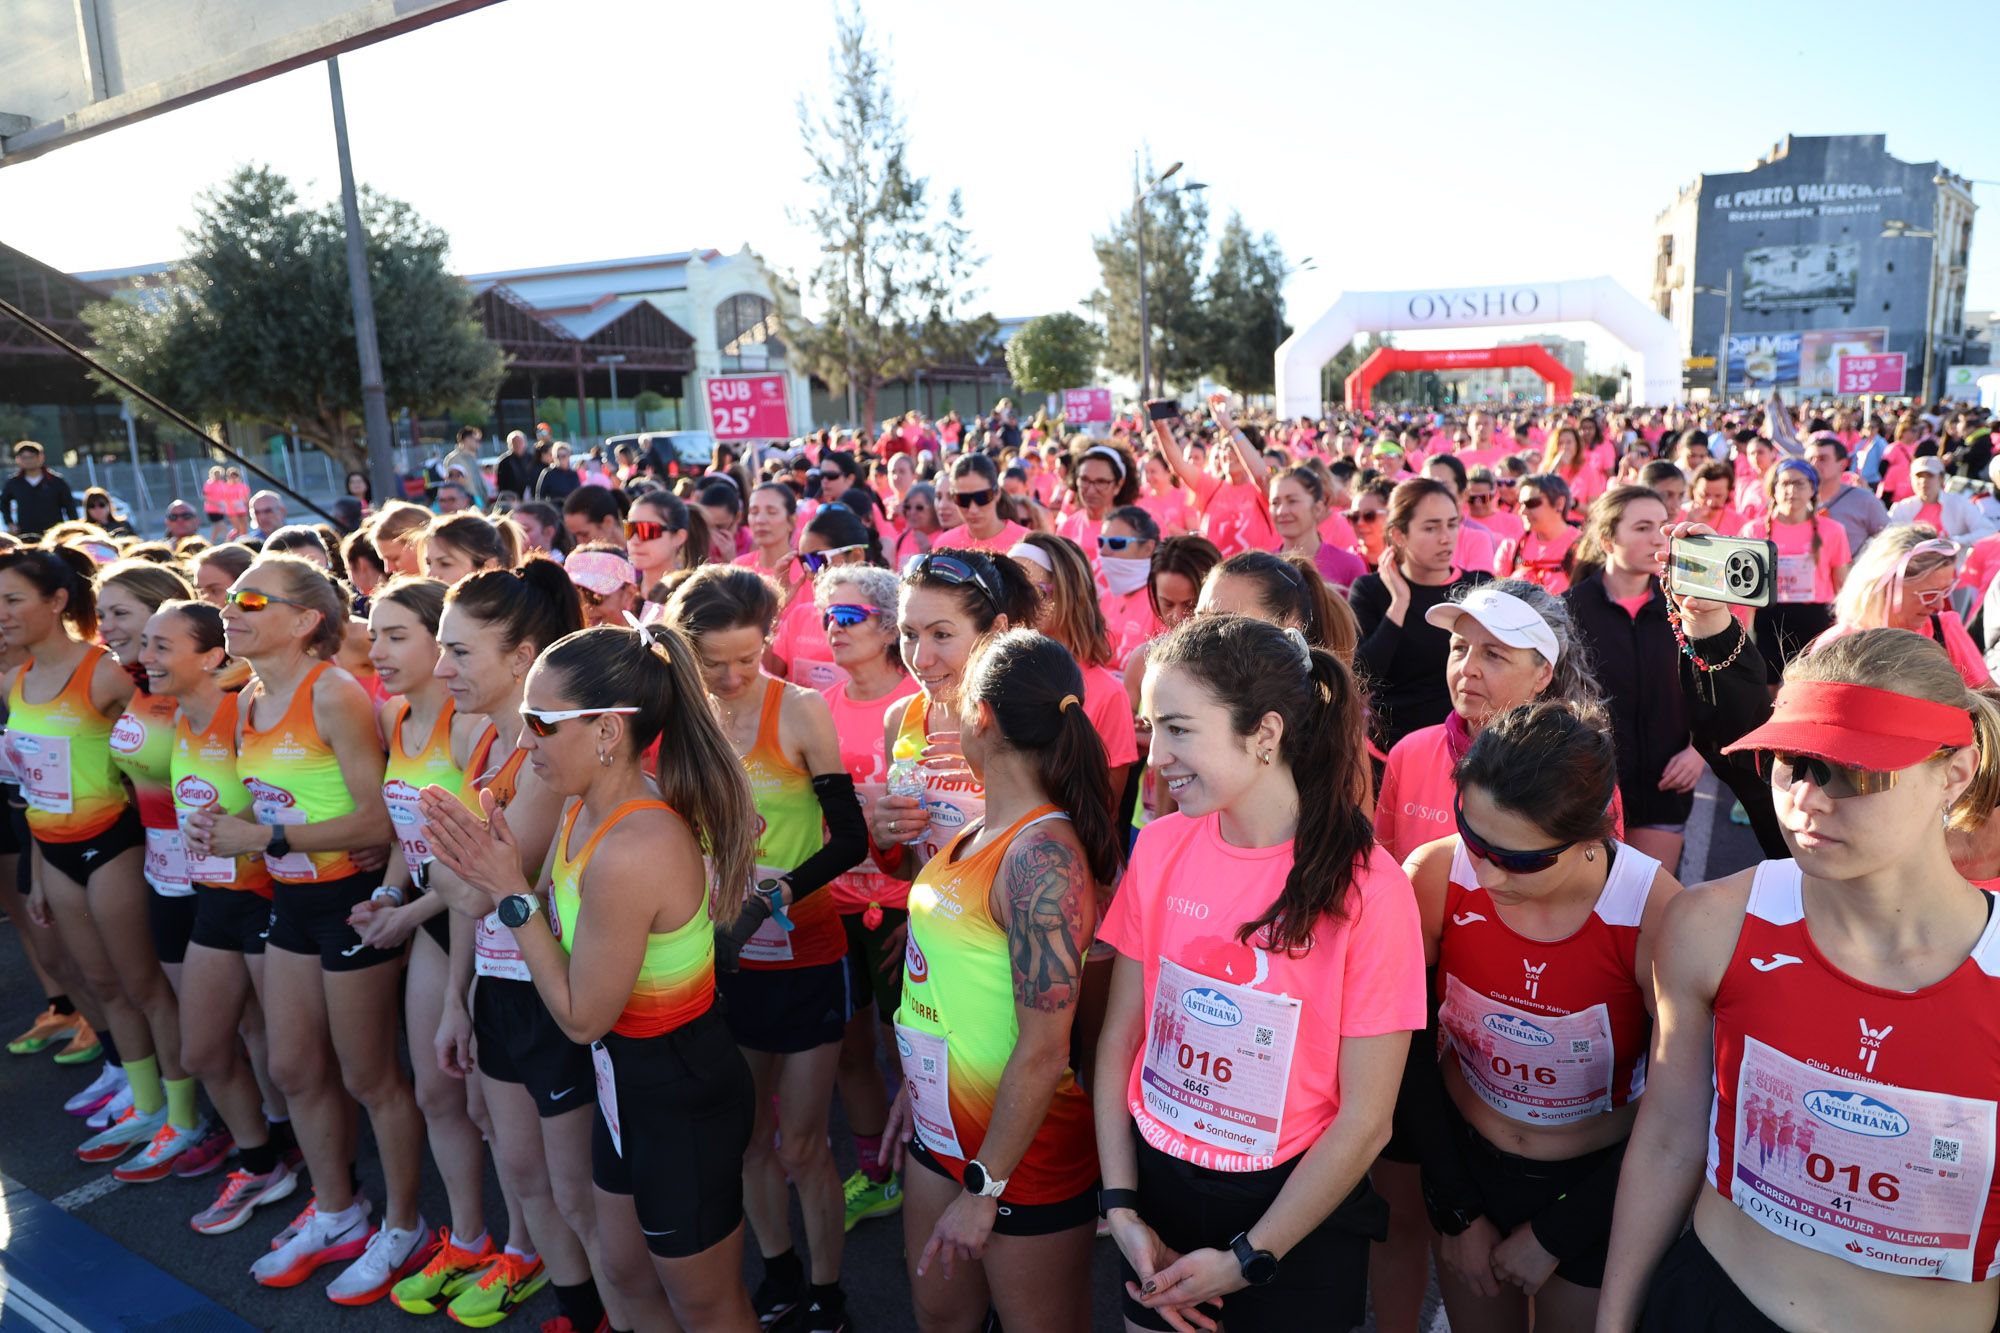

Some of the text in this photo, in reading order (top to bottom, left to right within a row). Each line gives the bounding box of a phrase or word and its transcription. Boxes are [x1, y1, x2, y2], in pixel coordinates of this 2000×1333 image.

[1734, 186, 1794, 208] PUERTO
[1728, 207, 1814, 222] Restaurante
[1408, 288, 1539, 322] OYSHO
[1846, 359, 1876, 371] SUB
[710, 381, 751, 402] SUB
[714, 405, 756, 435] 25'
[111, 727, 140, 744] errano
[26, 767, 43, 781] 16
[180, 784, 213, 800] Serrano
[252, 790, 288, 803] errano
[1525, 973, 1540, 981] CAX
[1184, 994, 1236, 1023] ASTURIANA
[1490, 990, 1508, 1000] Club
[1509, 996, 1545, 1010] Atletisme
[1488, 1018, 1548, 1044] ASTURIANA
[1860, 1037, 1881, 1048] CAX
[1177, 1043, 1233, 1084] 016
[1492, 1056, 1557, 1085] 016
[1806, 1058, 1830, 1072] Club
[1183, 1078, 1209, 1096] 4645
[1512, 1084, 1528, 1094] 42
[1756, 1077, 1794, 1103] SUMA
[1148, 1091, 1178, 1118] OYSHO
[1172, 1088, 1180, 1099] DE
[1180, 1092, 1188, 1102] LA
[1190, 1096, 1214, 1112] MUJER
[1220, 1108, 1257, 1126] VALENCIA
[1506, 1091, 1516, 1100] LA
[1518, 1094, 1545, 1106] MUJER
[1552, 1096, 1590, 1106] VALENCIA
[1542, 1106, 1592, 1120] Santander
[1810, 1096, 1900, 1133] ASTURIANA
[1206, 1124, 1257, 1146] Santander
[1168, 1139, 1188, 1160] DE
[1190, 1147, 1210, 1169] LA
[1214, 1154, 1274, 1172] MUJER
[1806, 1153, 1900, 1202] 016
[1755, 1180, 1941, 1245] CARRERA DE LA MUJER VALENCIA
[1831, 1197, 1852, 1212] 41
[1750, 1197, 1816, 1238] OYSHO
[1866, 1246, 1942, 1267] Santander
